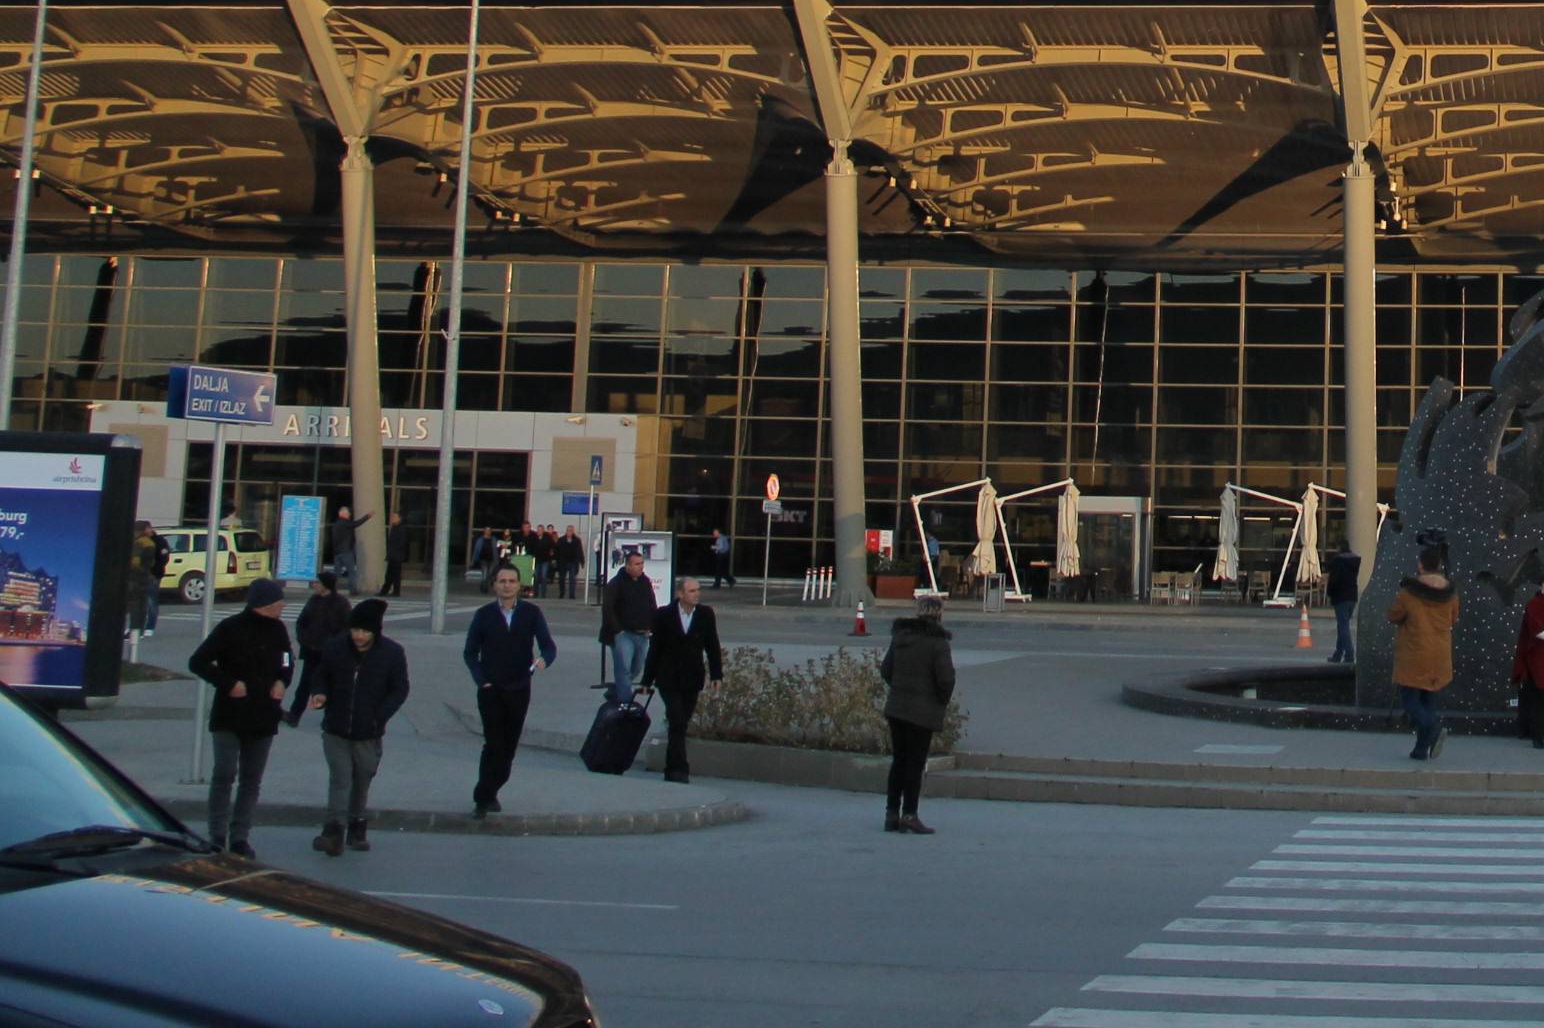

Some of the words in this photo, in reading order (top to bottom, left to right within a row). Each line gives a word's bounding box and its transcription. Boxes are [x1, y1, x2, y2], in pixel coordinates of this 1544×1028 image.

[193, 374, 229, 392] DALJA
[191, 398, 212, 412] EXIT
[219, 399, 246, 415] IZLAZ
[283, 413, 428, 440] ARRIALS
